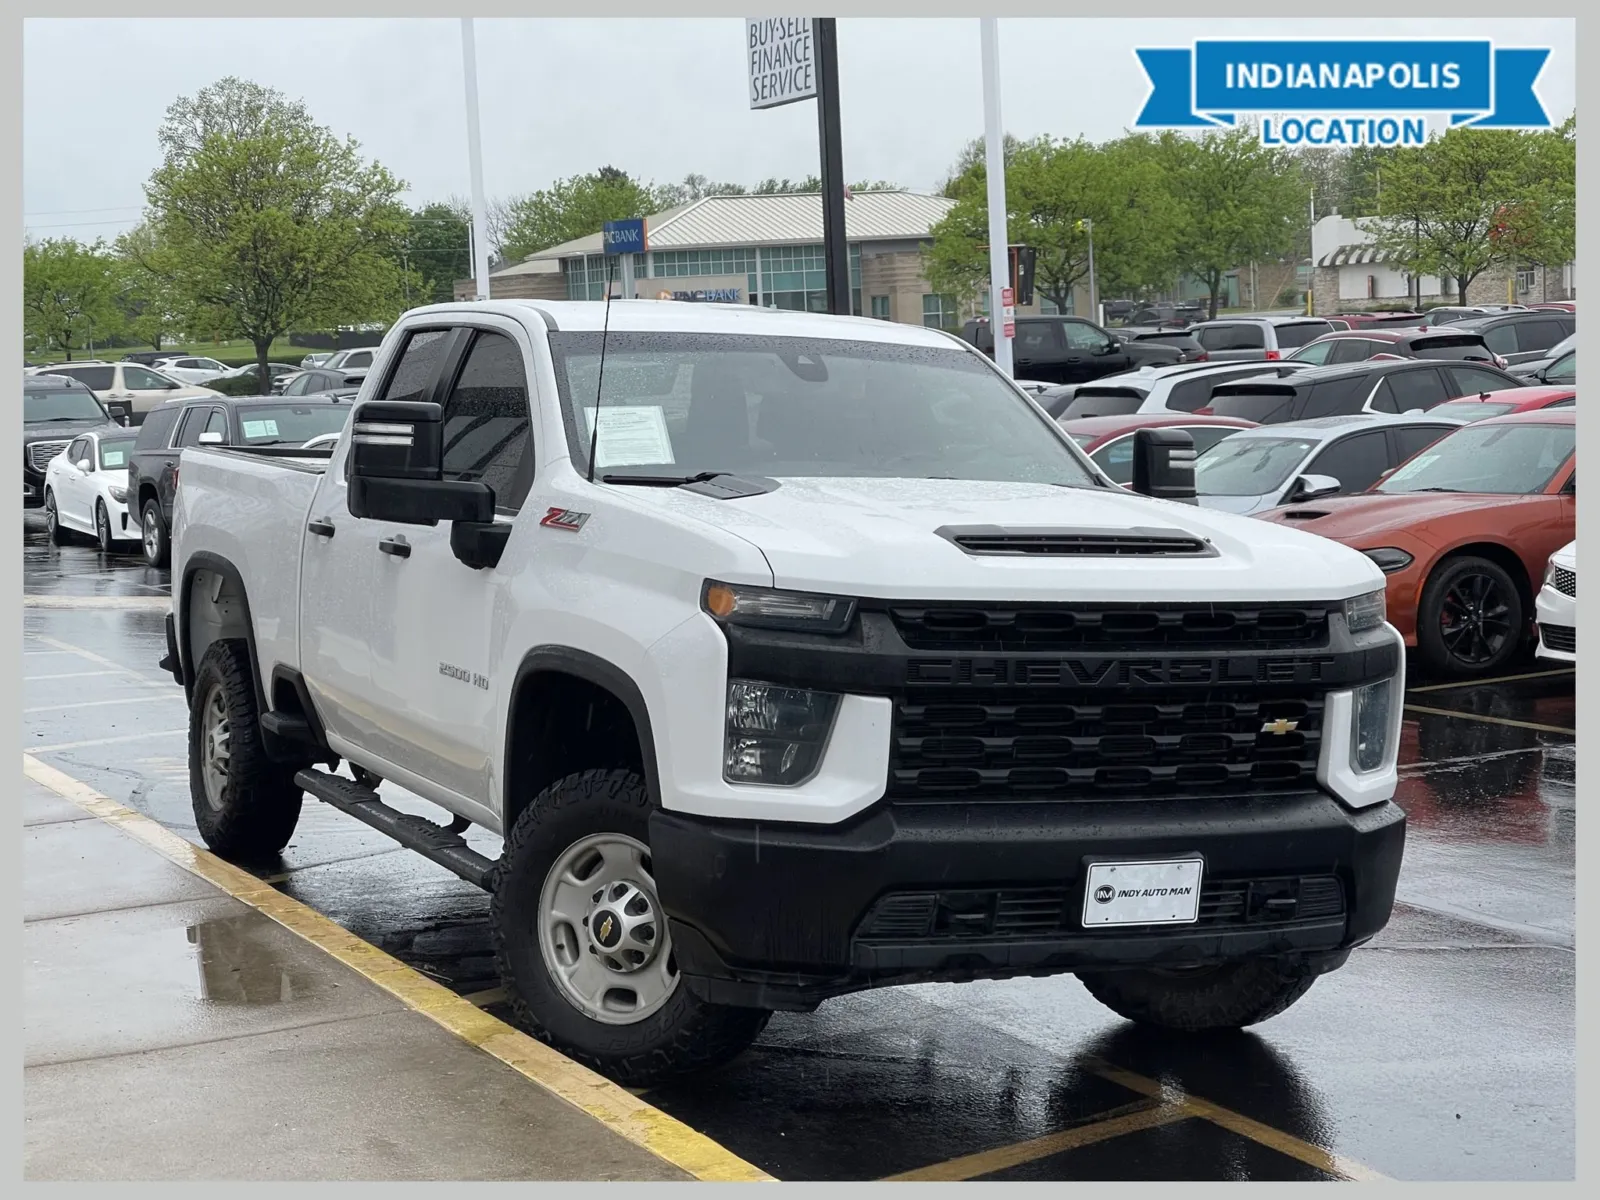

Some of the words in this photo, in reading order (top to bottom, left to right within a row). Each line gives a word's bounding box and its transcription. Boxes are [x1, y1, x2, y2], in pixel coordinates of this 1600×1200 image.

[751, 35, 810, 76] FINANCE
[752, 63, 812, 102] SERVICE
[439, 661, 471, 683] 2500
[473, 672, 489, 691] HD
[906, 656, 1335, 685] CHEVROLET
[1117, 889, 1141, 898] INDY
[1141, 888, 1168, 897] AUTO
[1168, 887, 1192, 896] MAN
